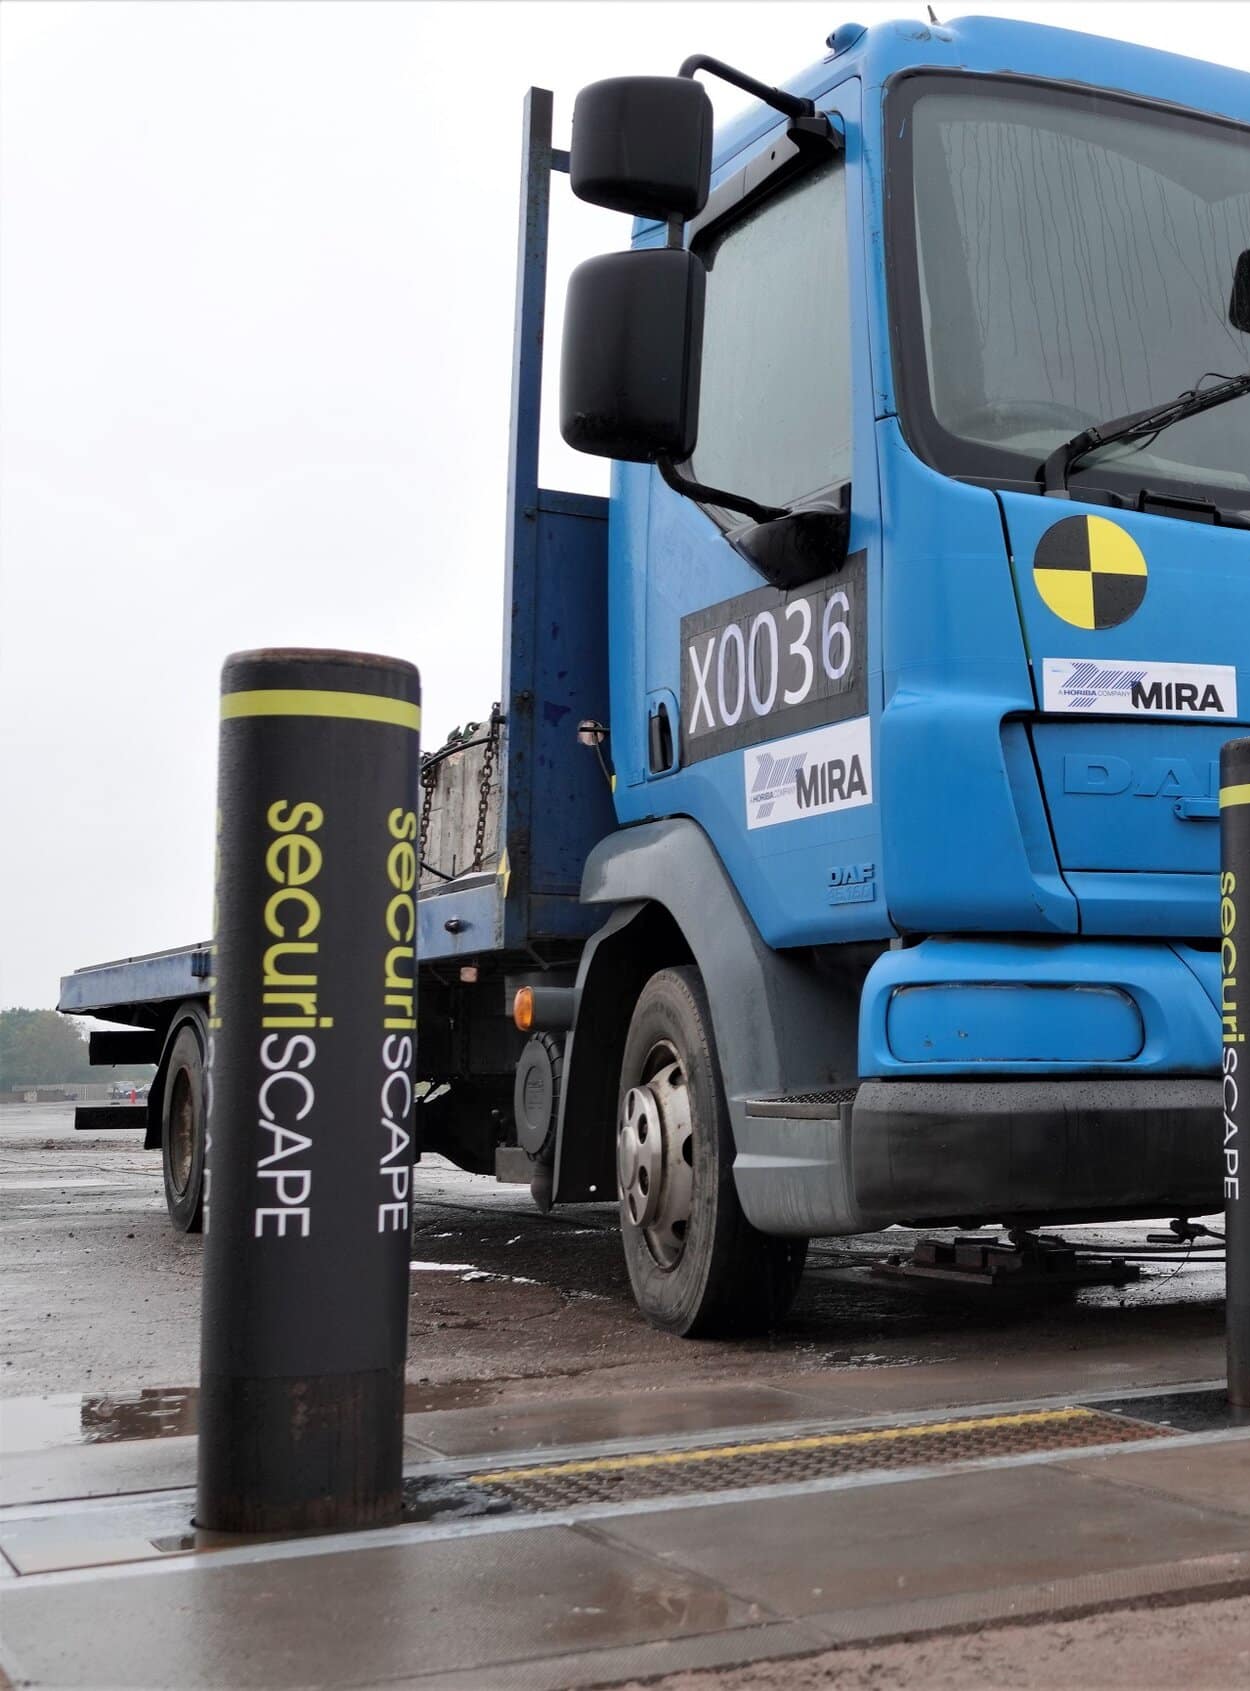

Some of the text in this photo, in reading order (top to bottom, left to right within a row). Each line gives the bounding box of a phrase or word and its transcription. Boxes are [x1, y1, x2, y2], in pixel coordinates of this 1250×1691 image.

[688, 591, 851, 735] X0036
[1130, 680, 1225, 712] MIRA
[795, 754, 868, 809] MIRA
[826, 864, 875, 887] DAF
[254, 799, 334, 1238] securiSCAPE
